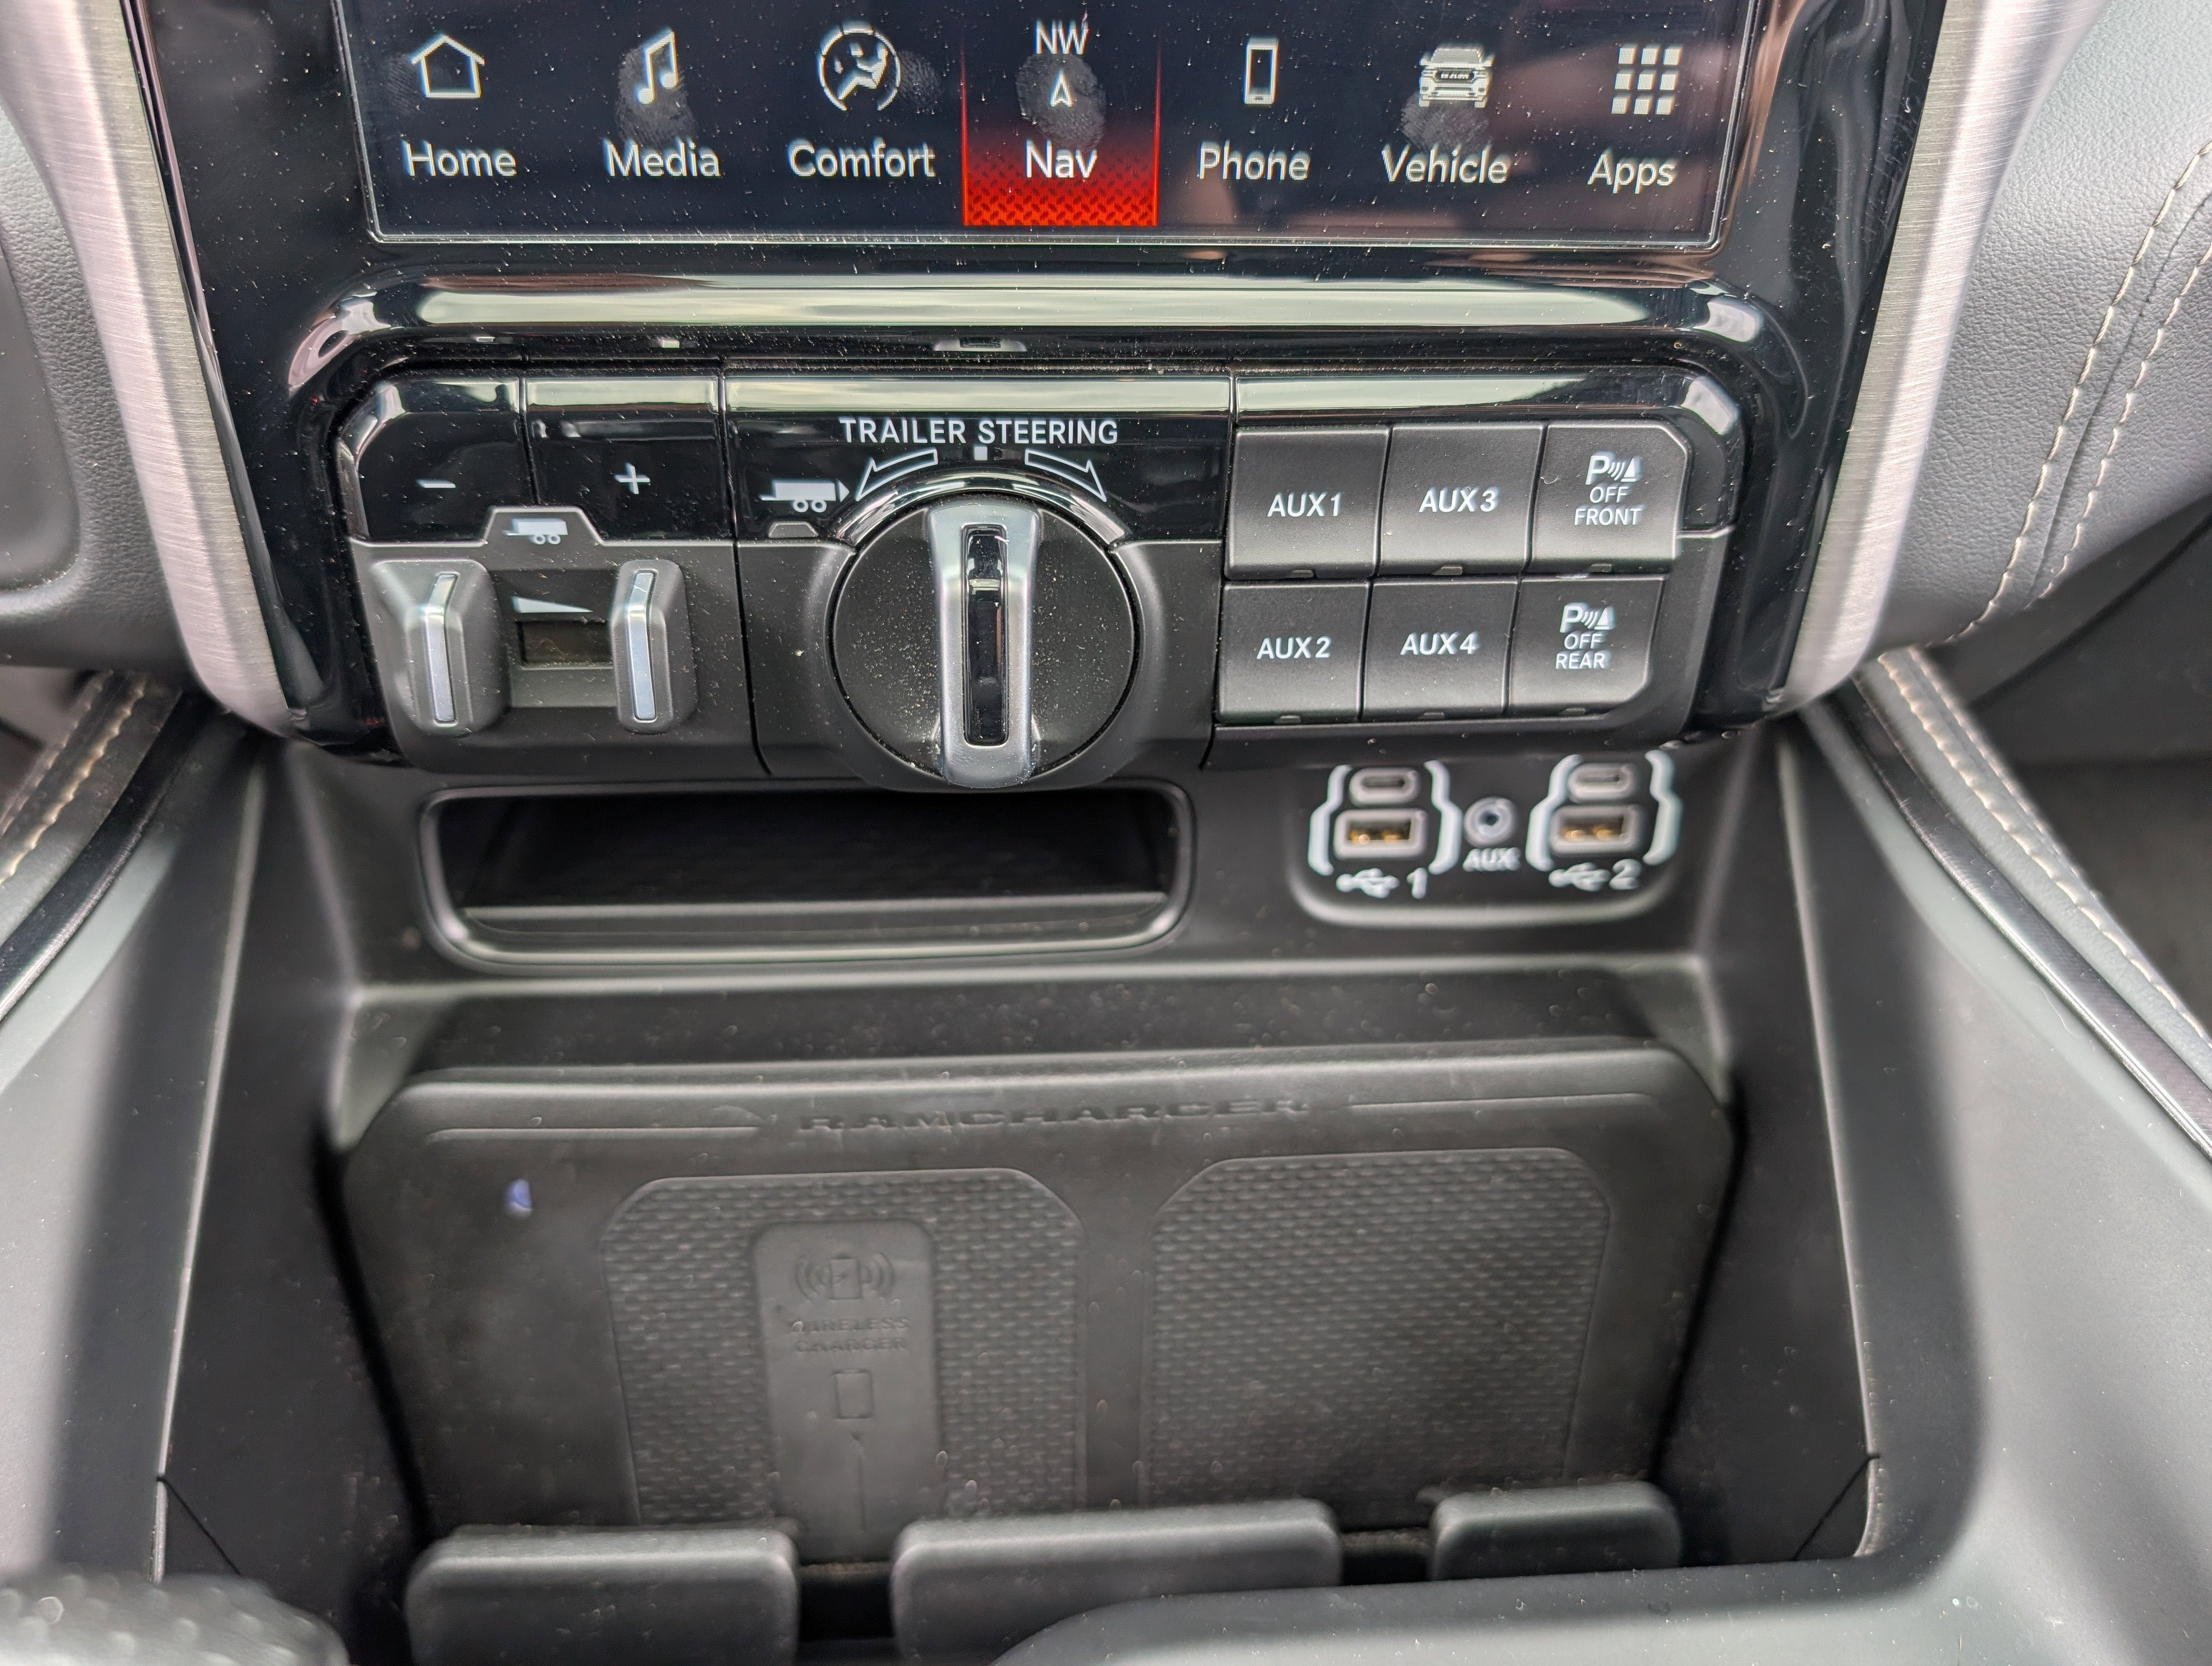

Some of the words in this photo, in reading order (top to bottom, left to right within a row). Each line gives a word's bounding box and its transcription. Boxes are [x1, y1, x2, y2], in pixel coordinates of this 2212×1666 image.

[1034, 20, 1088, 55] NW
[400, 141, 517, 178] Home
[602, 139, 721, 178] Media
[787, 139, 936, 178] Comfort
[1024, 140, 1097, 179] Nav
[1197, 142, 1310, 182] Phone
[1381, 143, 1509, 184] Vehicle
[1586, 150, 1676, 194] Apps
[839, 417, 967, 444] TRAILER
[978, 418, 1119, 445] STEERING
[1589, 485, 1631, 504] OFF
[1573, 507, 1644, 526] FRONT
[1564, 632, 1605, 650] OFF
[1555, 651, 1608, 670] REAR
[1463, 847, 1519, 871] AUX
